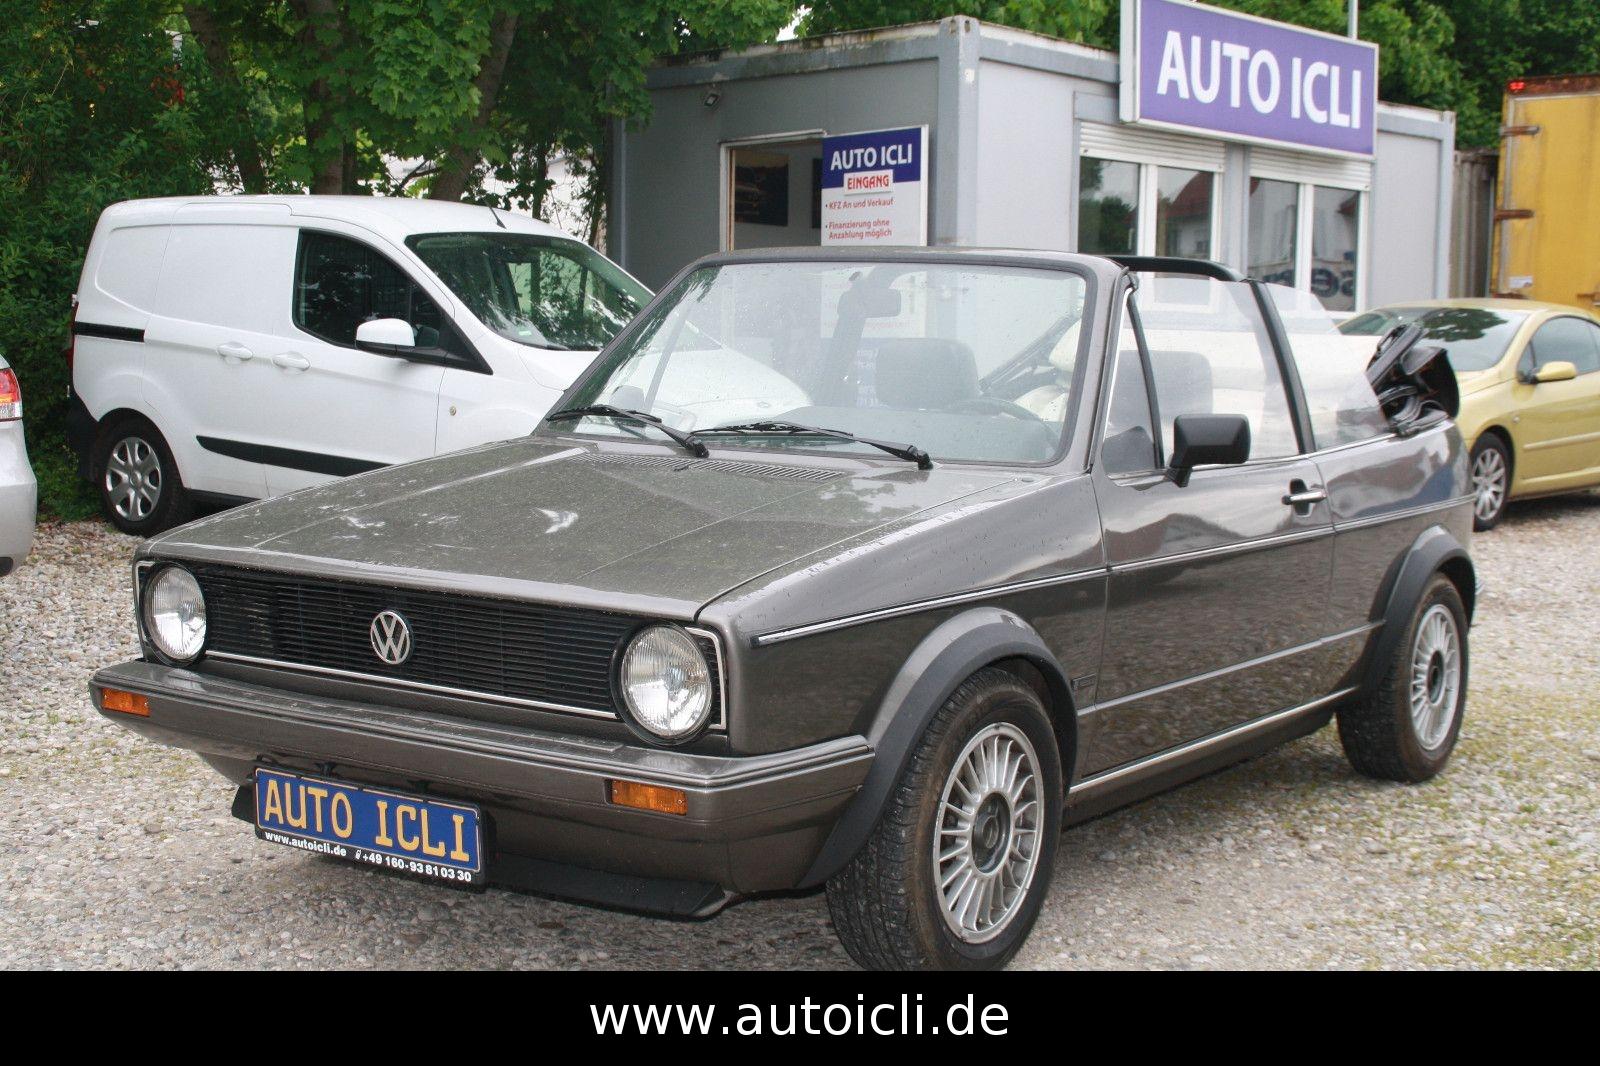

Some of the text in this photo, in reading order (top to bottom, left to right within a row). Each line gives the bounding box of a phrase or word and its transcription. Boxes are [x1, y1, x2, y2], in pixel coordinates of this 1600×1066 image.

[1157, 30, 1361, 129] AUTO ICLI
[830, 143, 912, 171] AUTO ICLI
[828, 197, 894, 210] KFZ An und Verkauf
[828, 218, 890, 230] Finanzierung ohne
[828, 228, 892, 240] Anzahlung möglich
[264, 779, 470, 862] AUTO ICLI
[265, 831, 347, 857] www.autoicli.de
[363, 852, 383, 864] +49
[425, 866, 439, 877] 81
[440, 868, 455, 879] 03
[457, 871, 472, 882] 30
